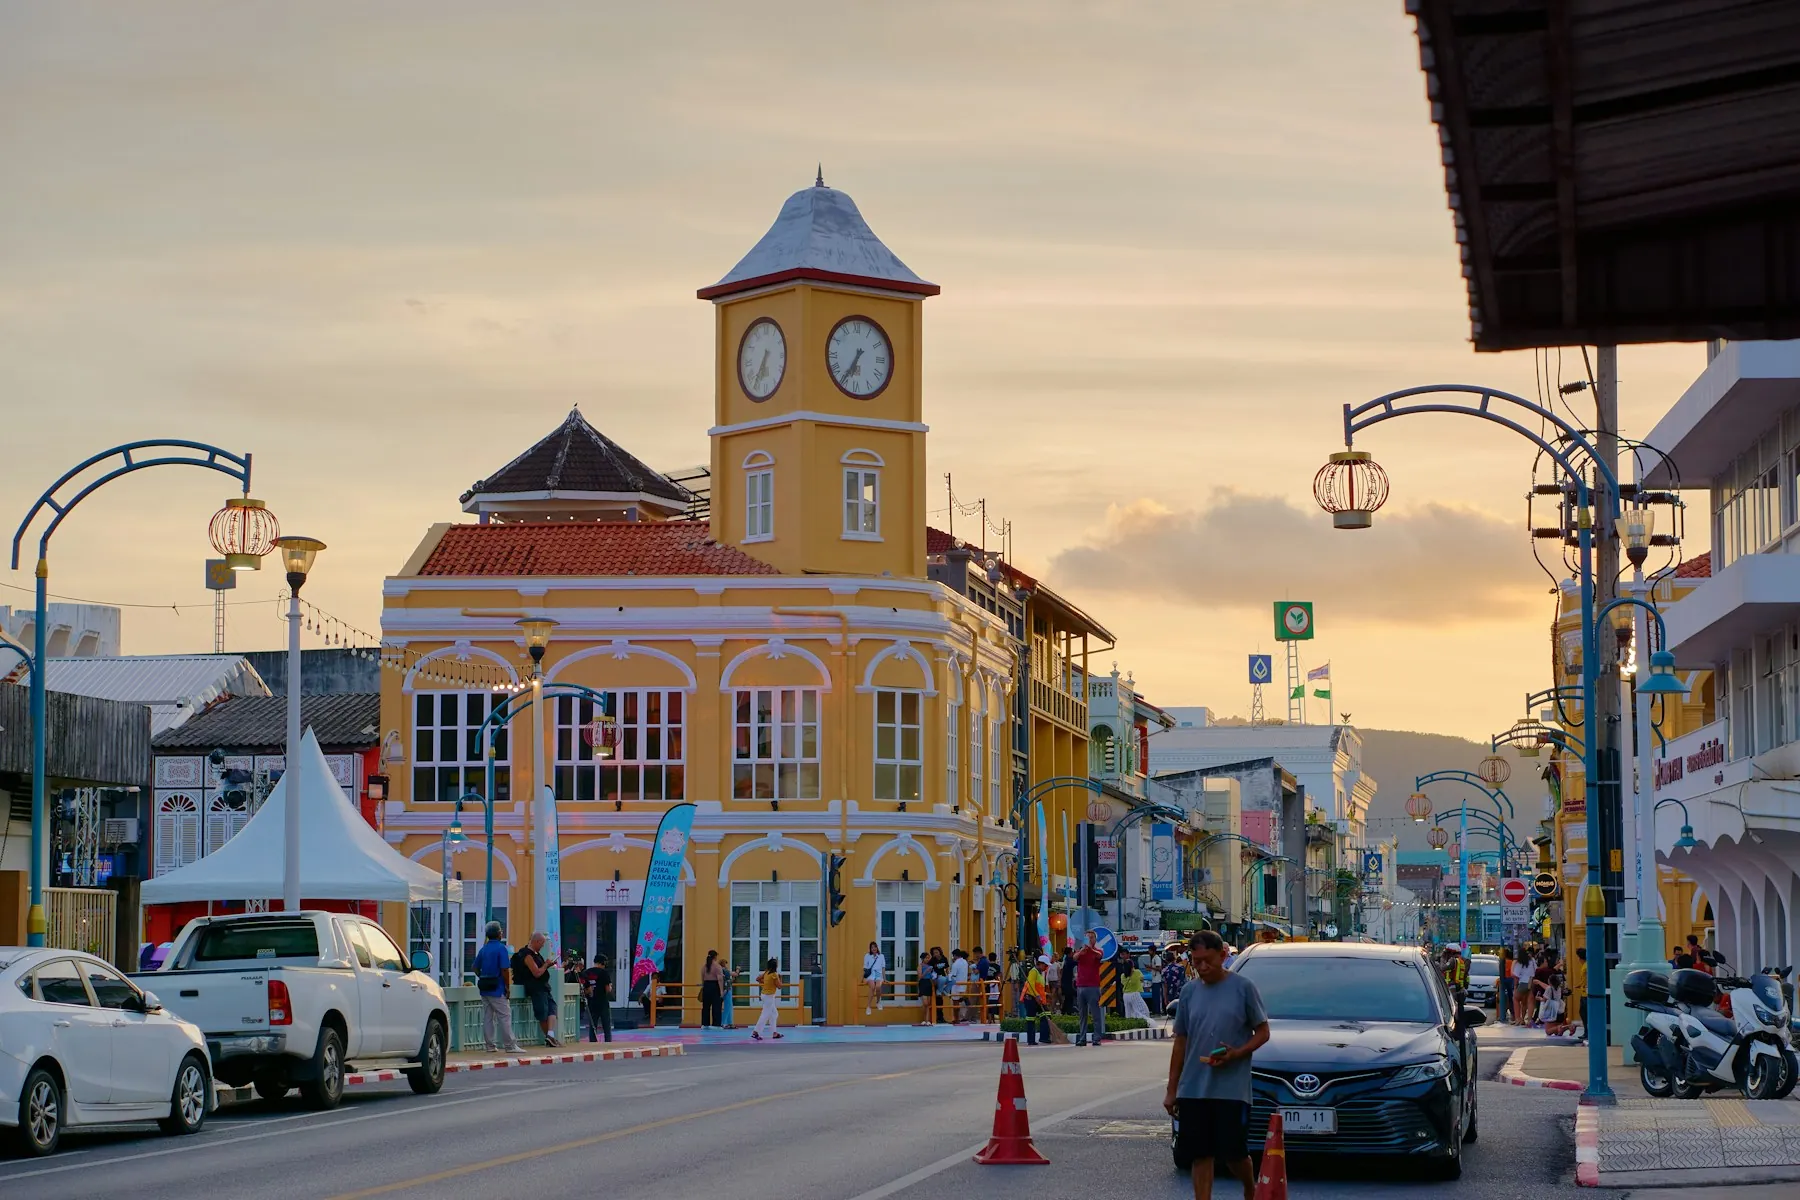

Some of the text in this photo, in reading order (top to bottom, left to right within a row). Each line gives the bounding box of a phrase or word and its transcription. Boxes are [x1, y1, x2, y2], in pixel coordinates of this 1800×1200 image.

[875, 356, 885, 364] III
[654, 860, 681, 868] PHUKET
[651, 874, 678, 882] NAKAN
[1503, 907, 1528, 916] ห้ามเข้า
[1312, 1111, 1324, 1122] 11
